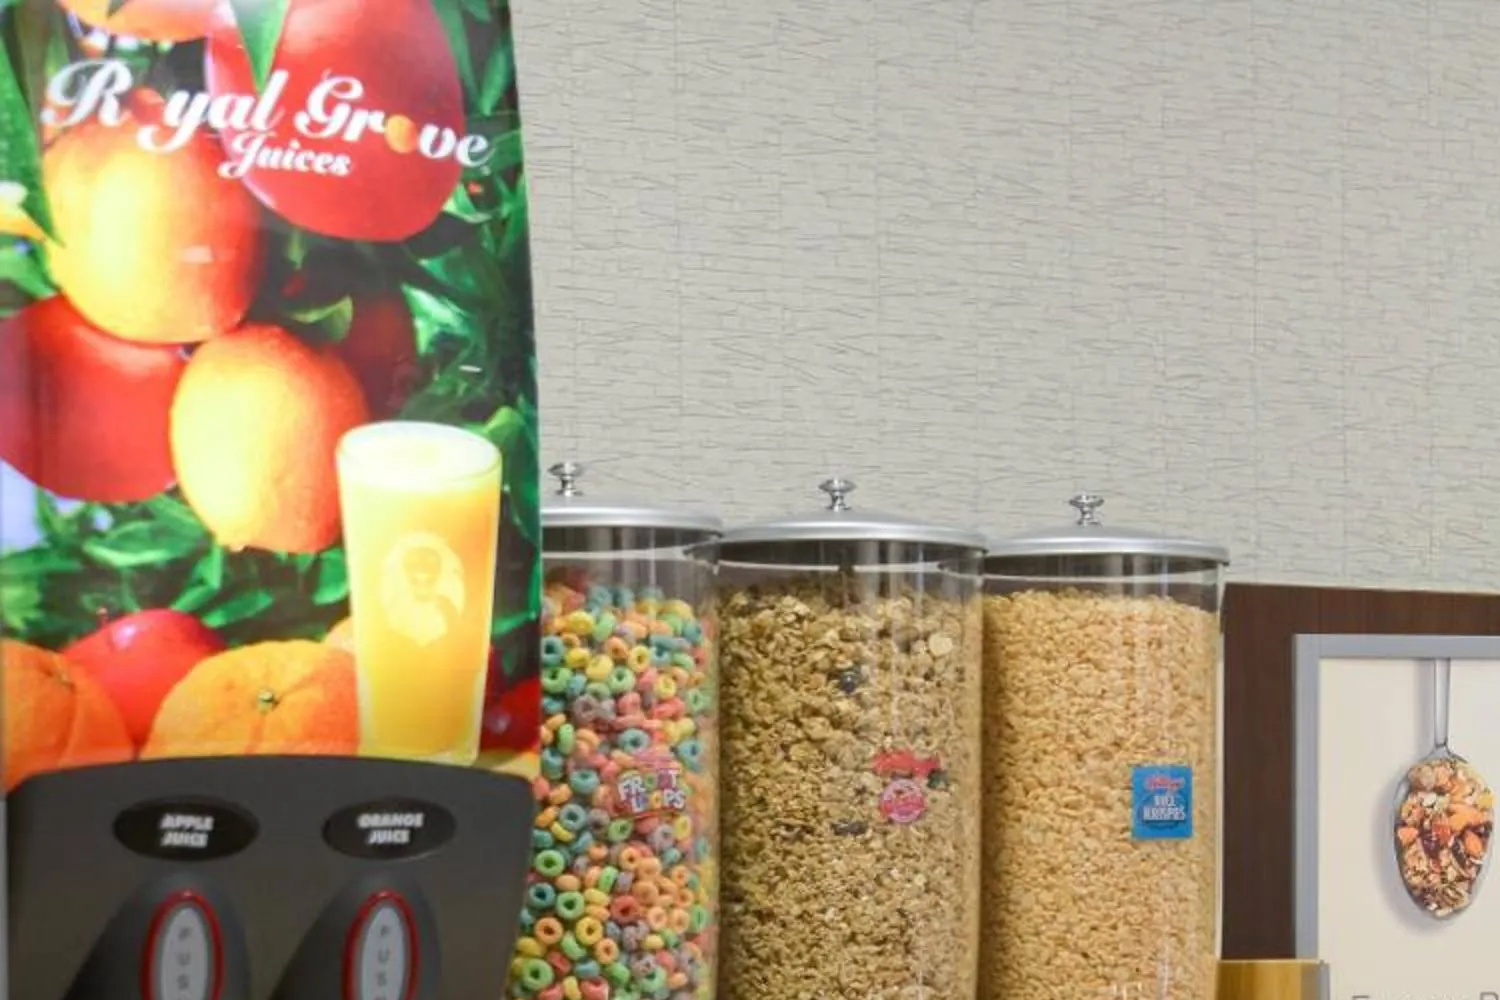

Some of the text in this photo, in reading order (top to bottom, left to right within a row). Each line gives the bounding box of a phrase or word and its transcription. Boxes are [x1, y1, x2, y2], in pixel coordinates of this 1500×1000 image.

[41, 59, 495, 168] Royal Grove
[218, 130, 352, 179] Juices
[160, 813, 214, 831] APPLE
[357, 813, 425, 829] ORANGE
[160, 830, 209, 848] JUICE
[367, 829, 412, 845] JUICE
